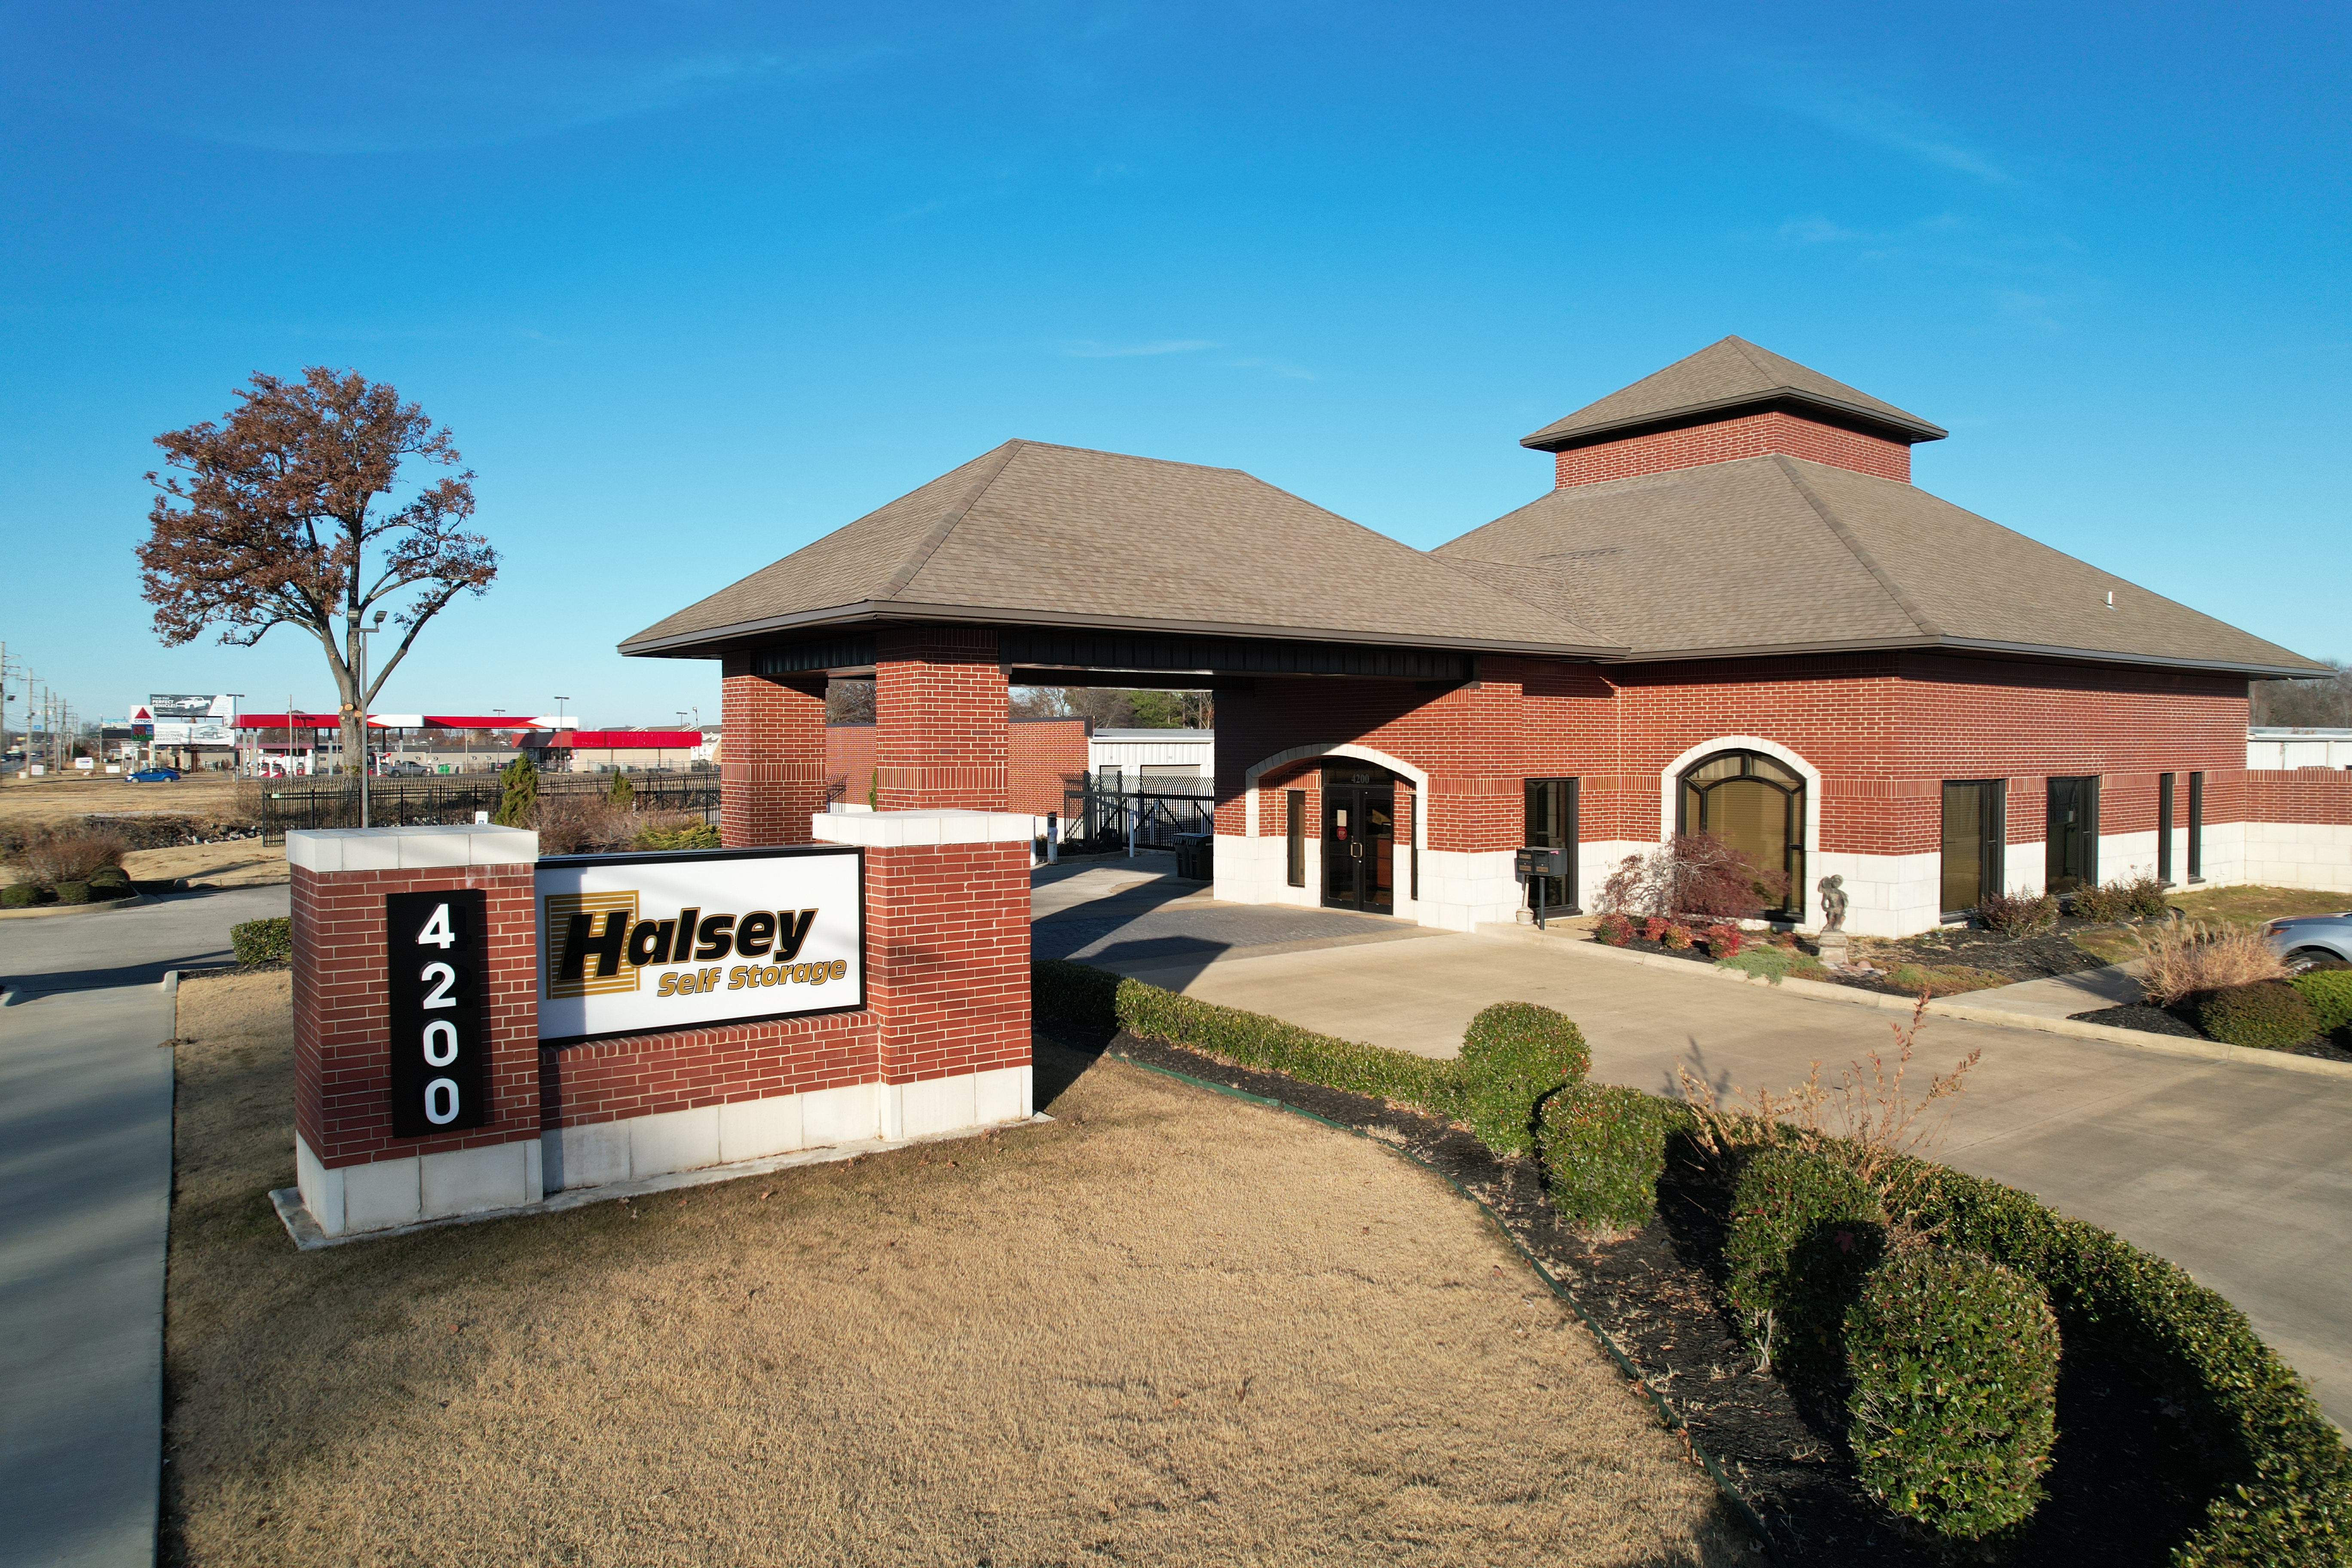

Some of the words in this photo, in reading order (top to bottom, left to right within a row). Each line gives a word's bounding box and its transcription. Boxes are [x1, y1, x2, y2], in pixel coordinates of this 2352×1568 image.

[1351, 774, 1370, 784] 4200
[557, 907, 819, 983] Halsey
[657, 967, 722, 997] Self
[728, 959, 847, 990] Storage
[416, 903, 460, 1125] 4200
